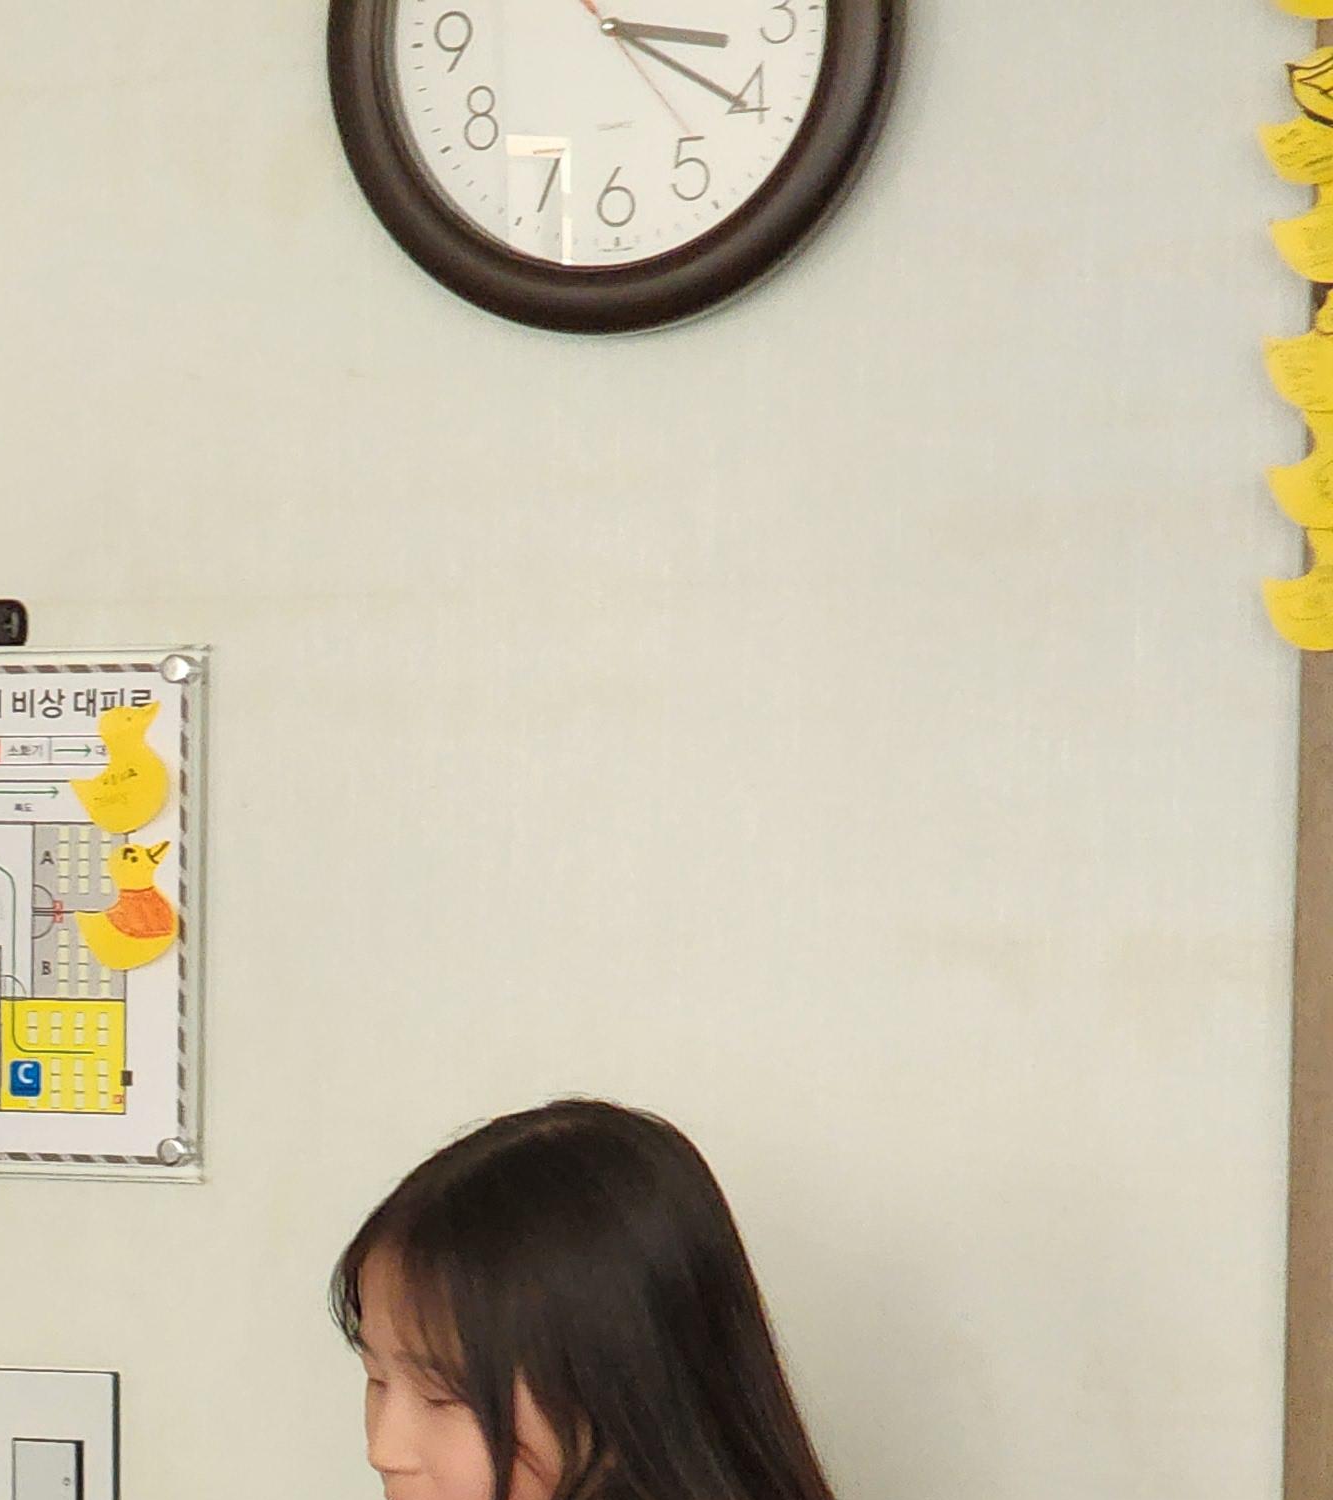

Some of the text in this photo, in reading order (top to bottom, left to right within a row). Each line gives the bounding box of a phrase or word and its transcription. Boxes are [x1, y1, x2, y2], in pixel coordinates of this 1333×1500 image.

[433, 10, 474, 73] 9
[463, 84, 500, 151] 8
[724, 60, 773, 124] 4
[533, 147, 567, 214] 7
[596, 165, 637, 227] 6
[669, 135, 711, 201] 5
[12, 688, 66, 719] 비상
[40, 851, 55, 866] A
[41, 961, 52, 976] B
[16, 1062, 35, 1085] C
